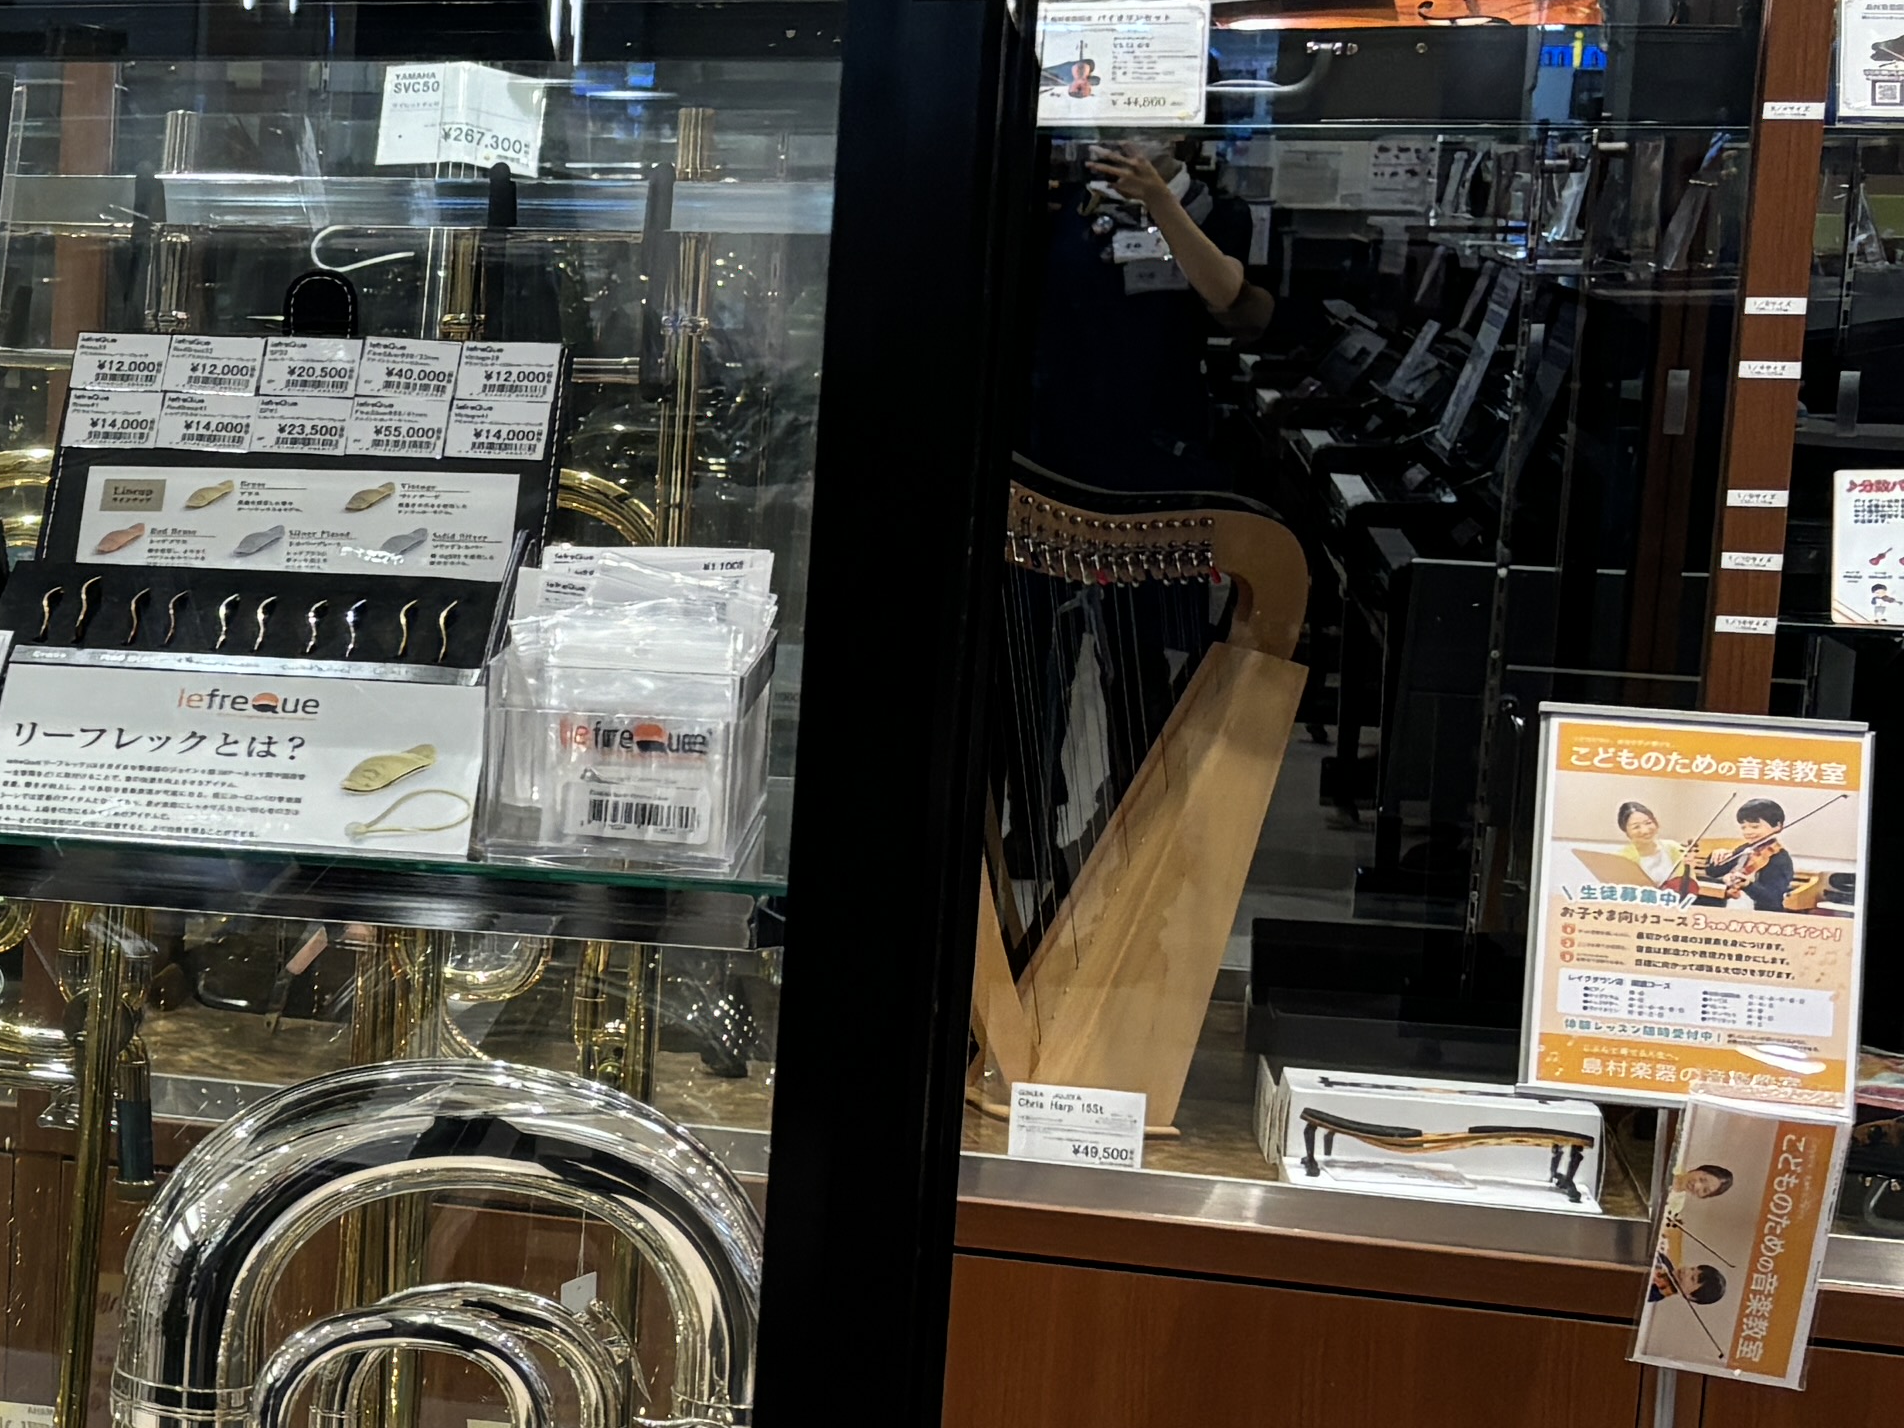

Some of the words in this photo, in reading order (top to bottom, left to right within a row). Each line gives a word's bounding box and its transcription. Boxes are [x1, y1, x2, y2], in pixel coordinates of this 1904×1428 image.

[395, 72, 436, 81] YAMAHA
[393, 81, 440, 95] SVC50
[441, 127, 523, 155] ¥267,300
[97, 360, 156, 372] ¥12,000
[191, 362, 249, 376] ¥12,000
[287, 366, 347, 378] ¥20,500
[386, 367, 446, 382] ¥40,000
[484, 370, 546, 383] ¥12,000
[90, 419, 148, 430] ¥14,000
[184, 421, 242, 433] ¥14,000
[278, 424, 337, 437] ¥23,500
[374, 425, 435, 439] ¥55,000
[473, 429, 535, 442] ¥14,000
[177, 687, 320, 718] lefreQue
[13, 720, 307, 761] リーフレックとは?
[1570, 747, 1847, 786] こどものための音楽教室
[1580, 886, 1680, 907] 生徒募集中
[1560, 907, 1689, 928] お子さま向けコース
[1050, 1100, 1073, 1113] Harp
[1072, 1144, 1128, 1161] ¥49,500
[1733, 1133, 1807, 1364] こどものための音楽教室
